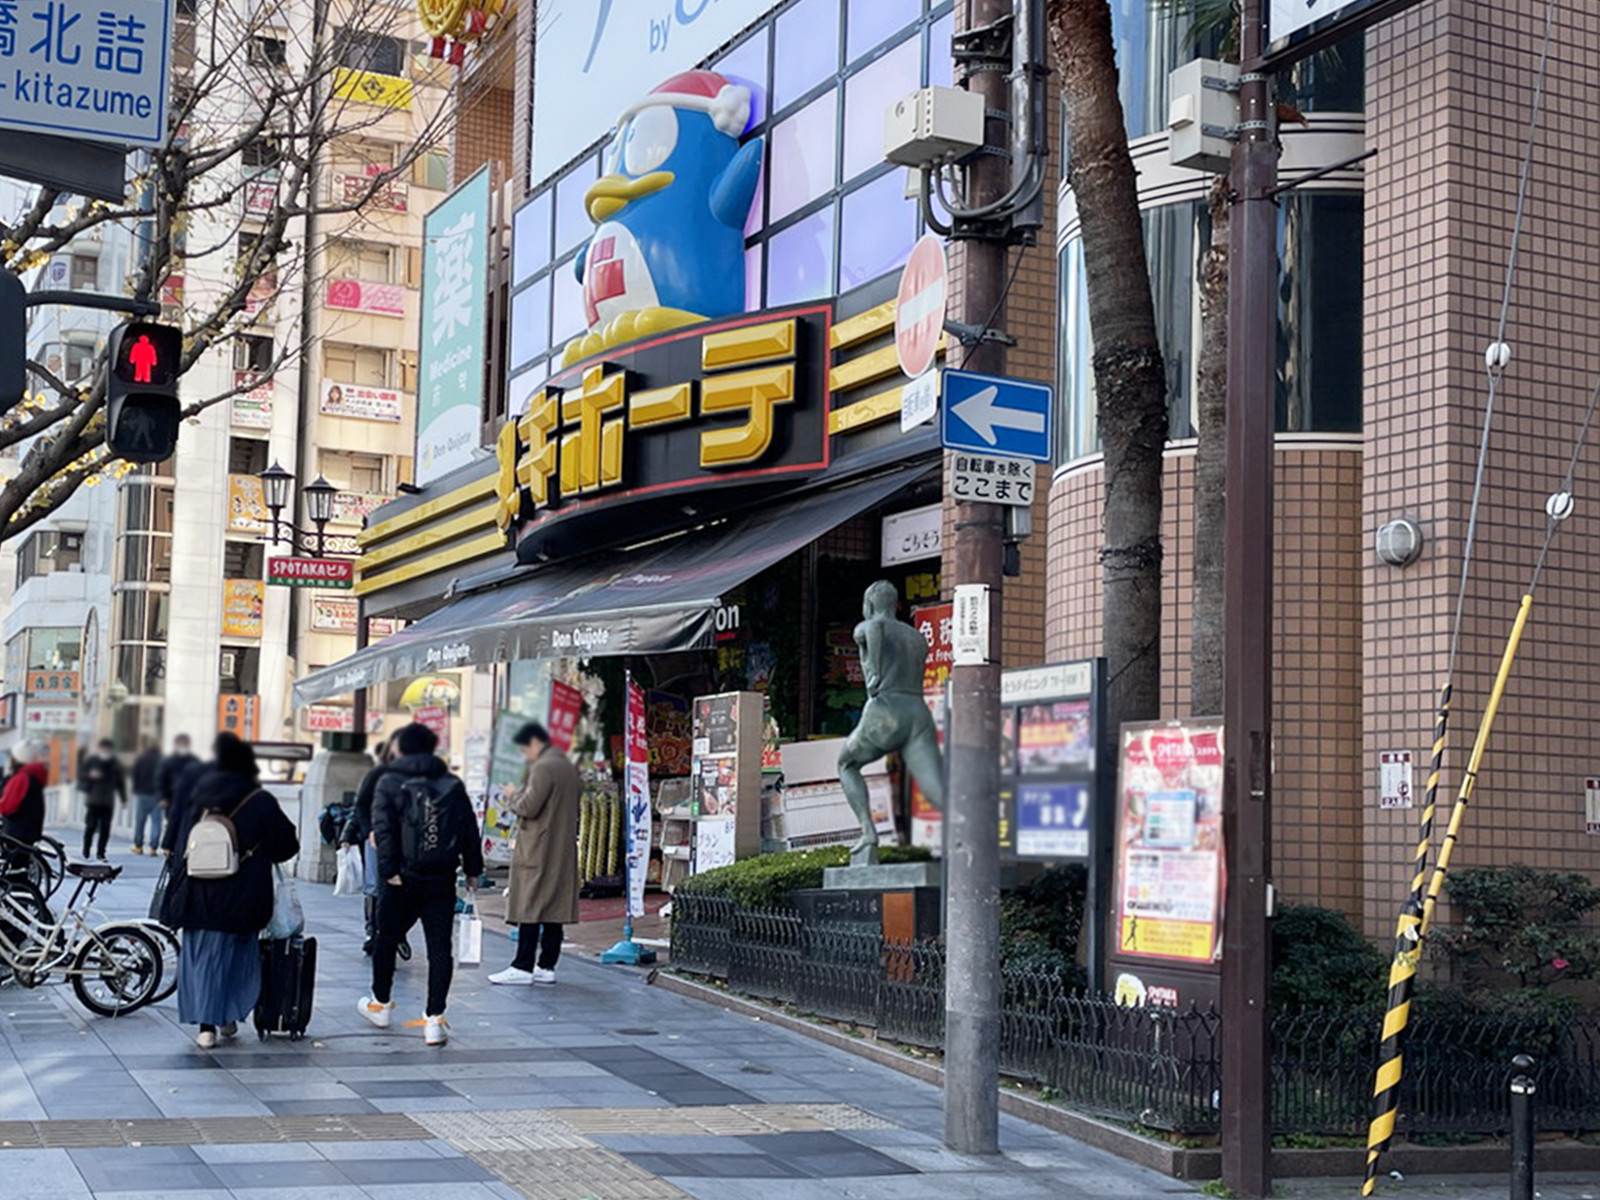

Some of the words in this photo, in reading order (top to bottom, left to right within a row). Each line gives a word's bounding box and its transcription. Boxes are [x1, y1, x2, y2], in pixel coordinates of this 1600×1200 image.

[650, 14, 671, 54] by
[429, 344, 472, 382] Medicine
[956, 457, 1032, 479] 自転車を除く
[954, 475, 1032, 501] ここまで
[901, 530, 940, 553] ごちそう
[273, 561, 348, 577] SPOTAKAビル
[553, 630, 571, 647] Don
[573, 627, 610, 650] Quijote
[427, 647, 442, 663] Don
[309, 716, 344, 730] KARIN
